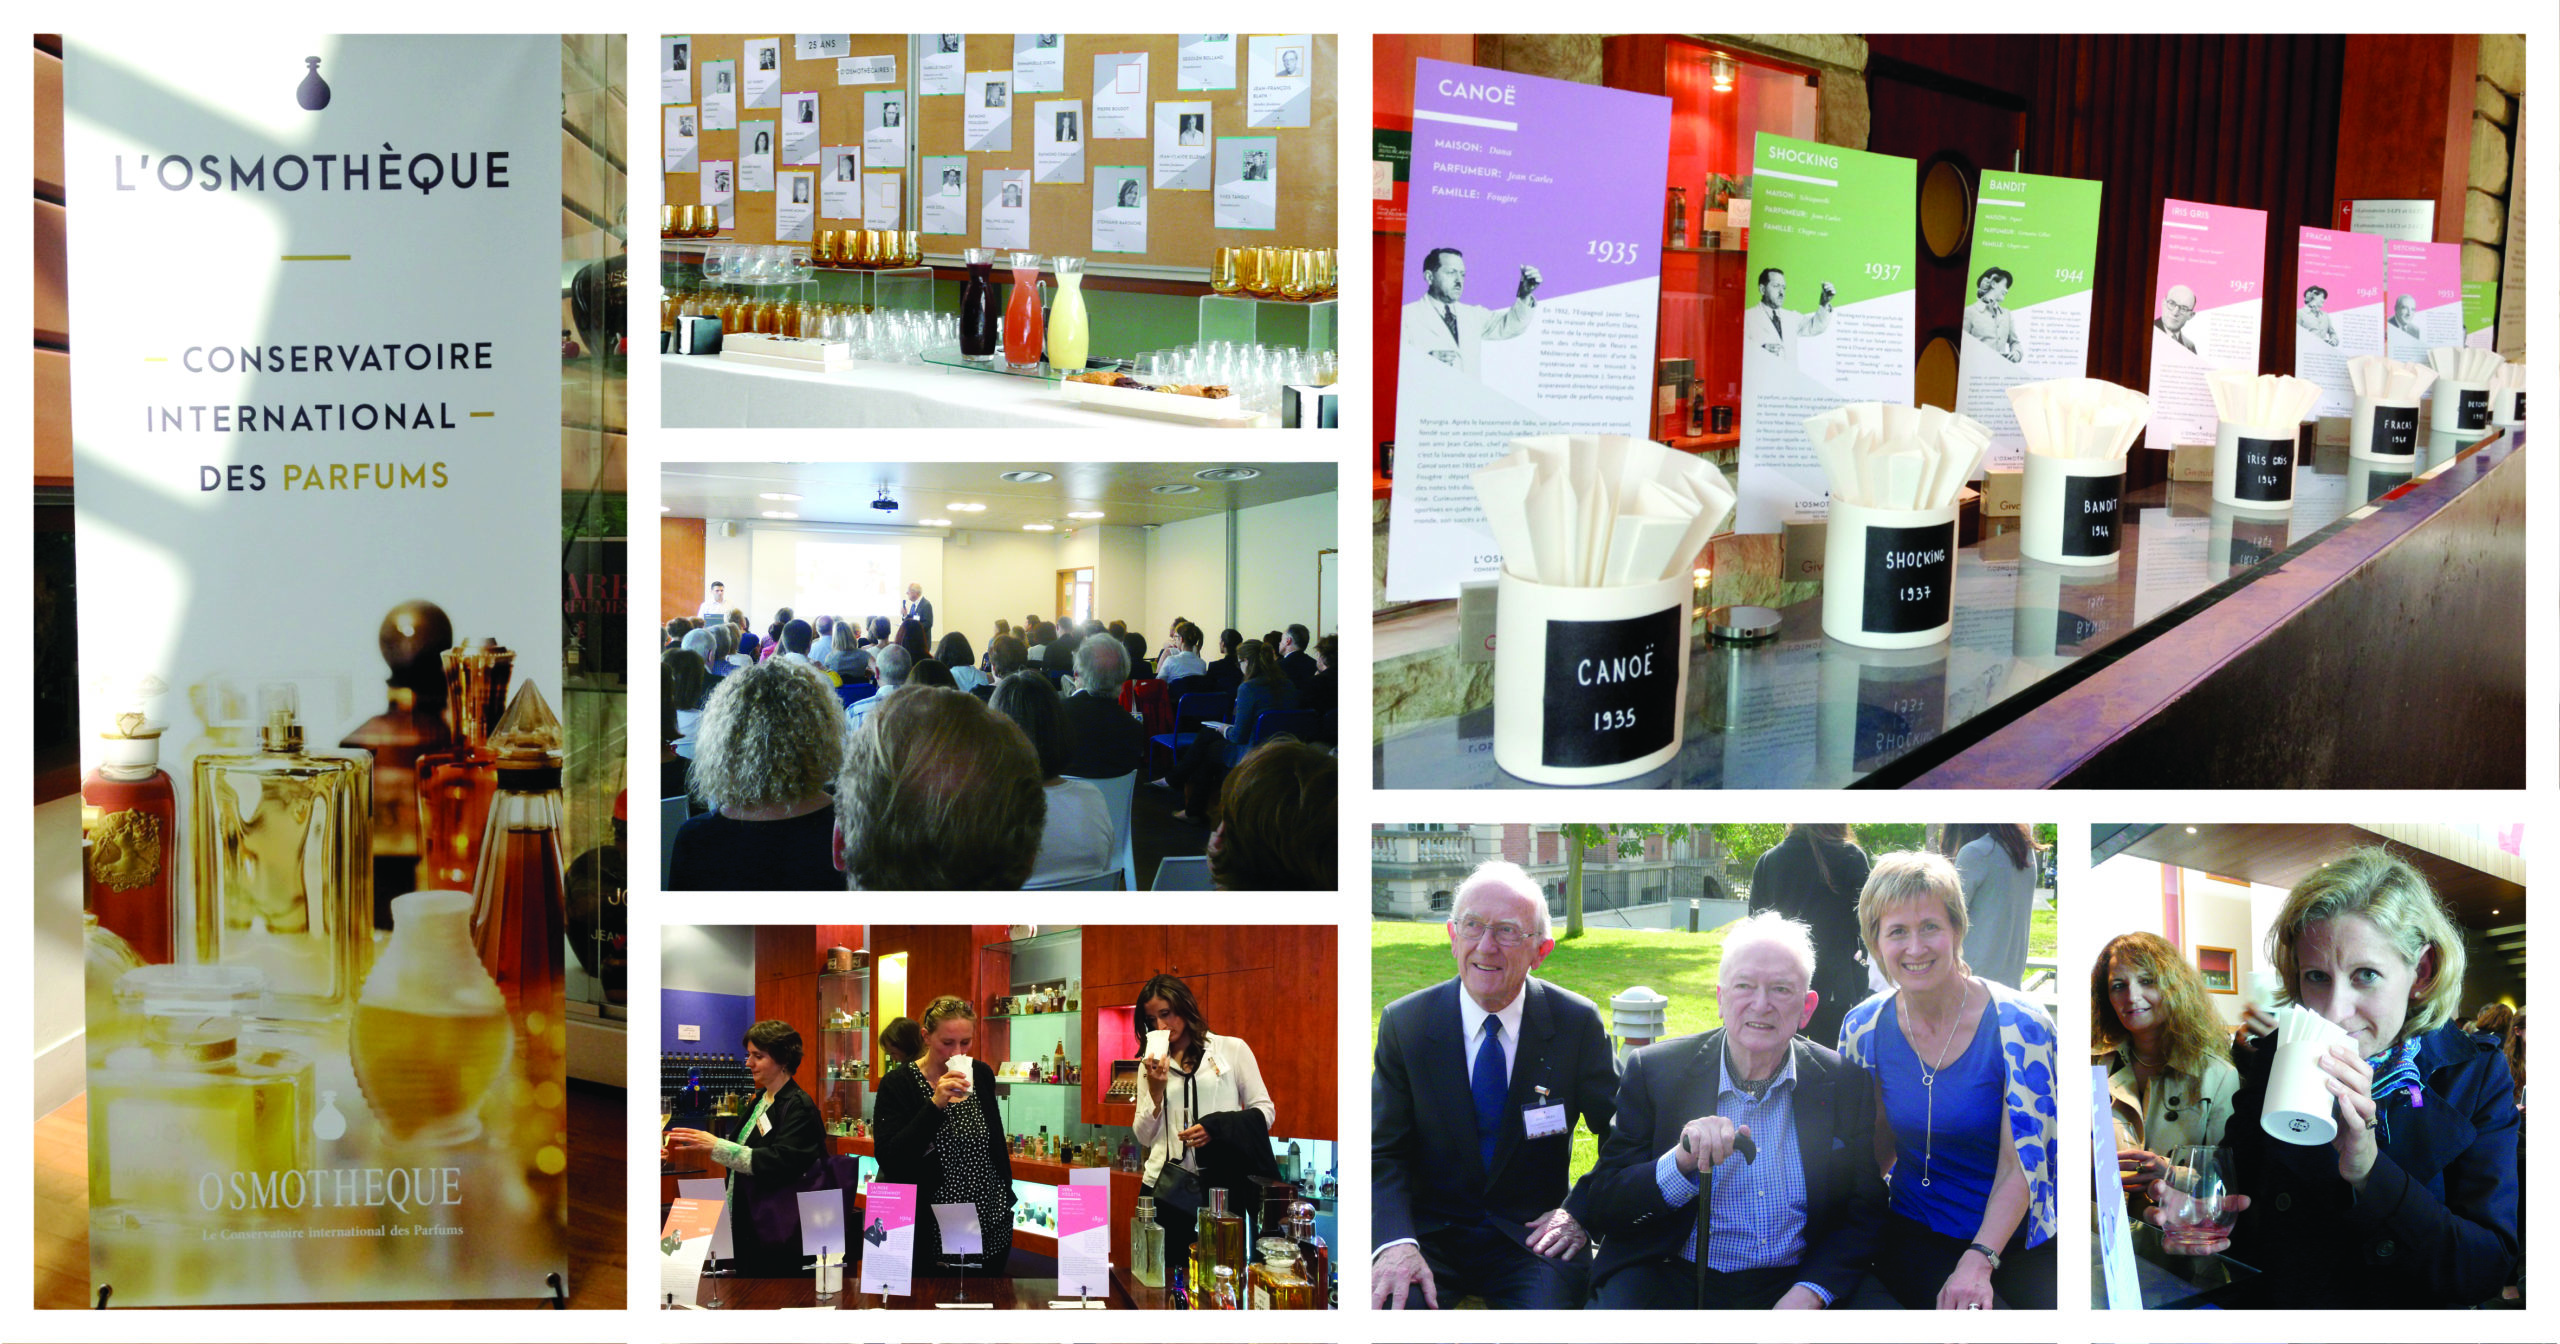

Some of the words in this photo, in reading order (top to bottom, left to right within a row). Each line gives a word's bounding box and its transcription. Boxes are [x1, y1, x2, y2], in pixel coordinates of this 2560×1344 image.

[808, 41, 816, 49] 25
[820, 40, 836, 48] ANS
[1439, 79, 1516, 106] CANOË
[1435, 140, 1482, 152] MAISON:
[1489, 146, 1512, 156] Dana
[1769, 146, 1839, 169] SHOCKING
[114, 142, 511, 195] L'OSMOTHÈQUE
[1433, 162, 1502, 178] PARFUMEUR:
[1507, 172, 1527, 181] Jean
[1529, 174, 1554, 184] Carles
[1989, 180, 2027, 192] BANDIT
[1432, 186, 1480, 199] FAMILLE:
[1486, 192, 1518, 204] Fougère
[2172, 207, 2187, 216] IRIS
[2190, 209, 2209, 219] GRIS
[2305, 232, 2332, 242] FRACAS
[1587, 240, 1639, 265] 1935
[1865, 263, 1901, 280] 1937
[2055, 268, 2084, 283] 1944
[2230, 279, 2255, 292] 1947
[2356, 286, 2378, 298] 1948
[183, 341, 493, 372] CONSERVATOIRE
[146, 402, 456, 432] INTERNATIONAL
[2384, 419, 2413, 430] FRACAS
[199, 465, 266, 491] DES
[284, 462, 450, 491] PARFUMS
[2258, 475, 2277, 486] 1947
[2092, 525, 2109, 537] 1944
[1900, 586, 1931, 601] 1937
[1577, 642, 1654, 686] CANOË
[1594, 707, 1636, 731] 1935
[199, 1168, 462, 1214] OSMOTHEQUE
[202, 1229, 217, 1241] Le
[221, 1228, 304, 1241] Conservatoire
[390, 1225, 409, 1237] des
[414, 1224, 464, 1236] Parfums
